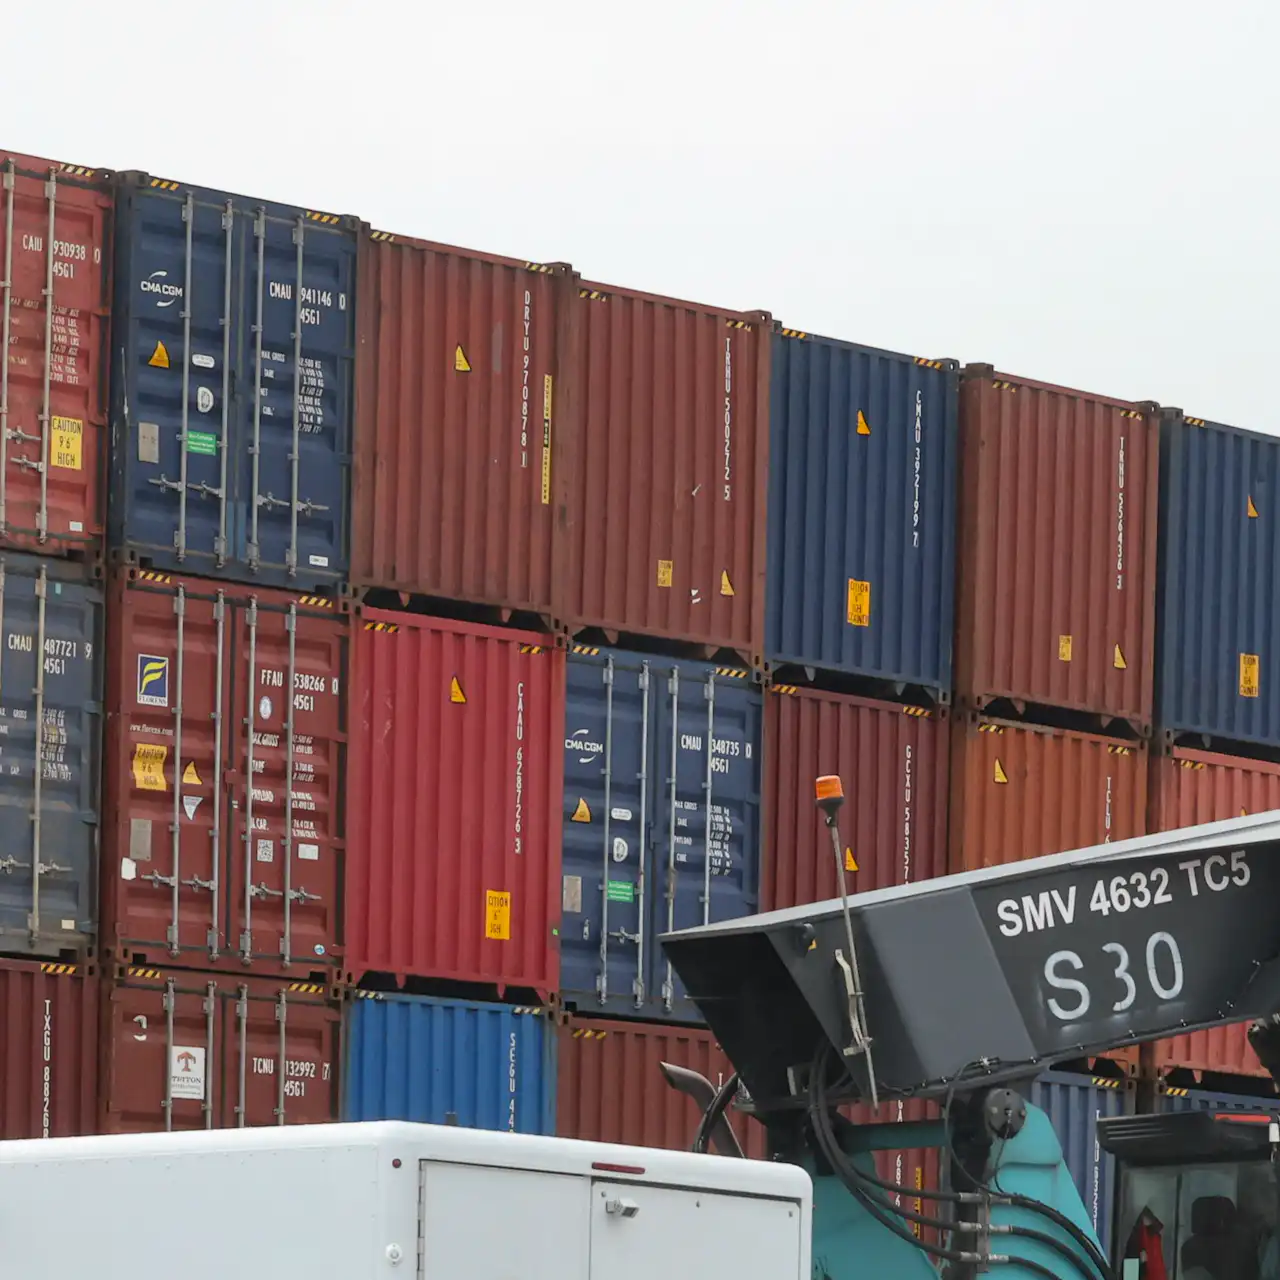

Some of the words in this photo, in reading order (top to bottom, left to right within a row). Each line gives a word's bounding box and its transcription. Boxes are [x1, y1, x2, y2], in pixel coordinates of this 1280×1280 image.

[23, 235, 42, 252] CAIU
[53, 240, 86, 260] 930938
[94, 249, 101, 264] 0
[53, 261, 74, 278] 45G1
[140, 281, 161, 293] CMA
[162, 284, 183, 297] CGM
[269, 282, 291, 299] CMAU
[301, 288, 332, 306] 941146
[339, 293, 346, 310] 0
[300, 310, 320, 325] 45G1
[521, 355, 529, 447] 970878
[52, 418, 81, 435] CAUTION
[57, 451, 76, 468] HIGH
[724, 485, 731, 501] 5
[8, 634, 32, 652] CMAU
[44, 638, 77, 658] 487721
[44, 658, 65, 675] 45G1
[261, 669, 283, 687] FFAU
[294, 673, 325, 692] 538266
[332, 677, 339, 694] 0
[293, 695, 314, 712] 45G1
[516, 682, 524, 741] CAAU
[565, 739, 583, 751] CMA
[584, 742, 603, 753] CGM
[681, 735, 702, 751] CMAU
[711, 739, 740, 756] 348735
[710, 758, 729, 774] 45G1
[515, 747, 523, 833] 628726
[514, 838, 522, 855] 3
[997, 886, 1076, 936] SMV
[1090, 868, 1173, 916] 4632
[1179, 850, 1251, 896] TC5
[252, 1057, 274, 1074] TCNU
[285, 1061, 315, 1078] 132992
[284, 1080, 305, 1097] 45G1
